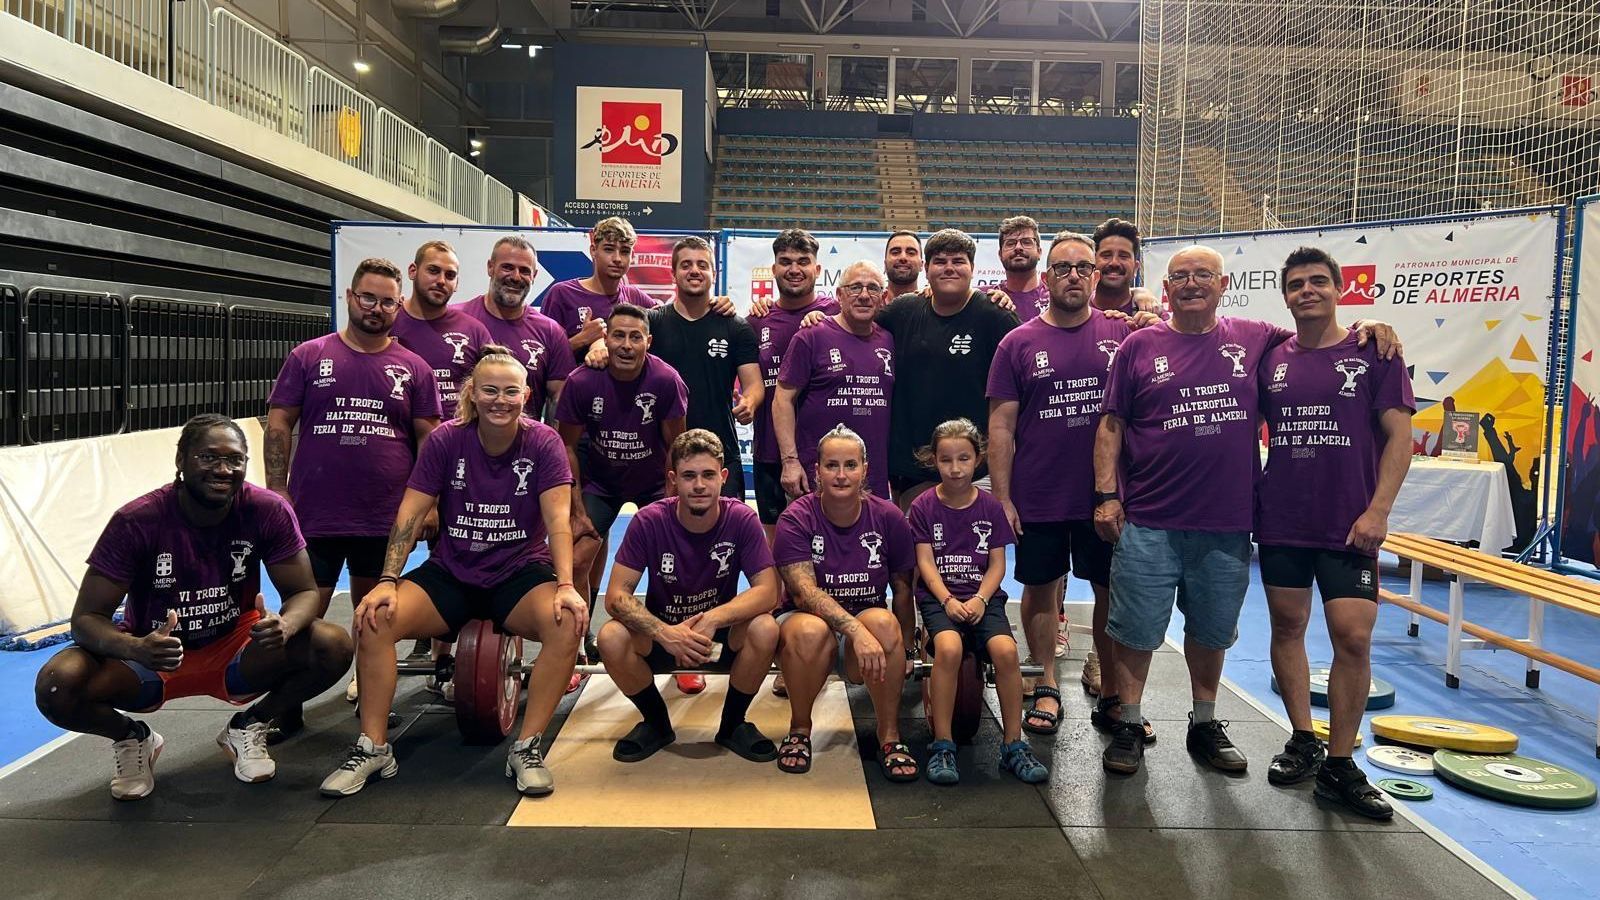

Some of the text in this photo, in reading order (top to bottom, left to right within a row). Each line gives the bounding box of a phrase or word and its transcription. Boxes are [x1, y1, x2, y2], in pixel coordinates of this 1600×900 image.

[601, 170, 646, 179] DEPORTES
[1394, 261, 1448, 269] PATRONATO
[1451, 257, 1501, 267] MUNICIPAL
[1393, 270, 1504, 288] DEPORTES
[1392, 286, 1520, 304] DE ALMERIA
[856, 376, 879, 384] TROFEO
[1054, 377, 1098, 390] VI TROFEO
[837, 388, 884, 396] HALTEROFILIA
[1180, 383, 1230, 397] VI TROFEO
[336, 398, 383, 409] VI TROFEO
[827, 398, 848, 406] FERIA
[1172, 397, 1238, 414] HALTEROFILIA
[1039, 408, 1062, 419] FERIA
[1066, 406, 1077, 416] DE
[1282, 406, 1330, 416] VI TROFEO
[326, 411, 388, 424] HALTEROFILIA
[1163, 410, 1247, 430] FERIA DE ALMERIA
[314, 424, 396, 438] FERIA DE ALMERIA
[1195, 424, 1221, 436] 2024
[1277, 421, 1338, 432] ALTEROFILIA
[612, 431, 638, 440] TROFEO
[1292, 435, 1302, 445] DE
[1307, 435, 1351, 446] ALMERIA
[608, 448, 653, 460] DE ALMERIA
[465, 502, 510, 514] VI TROFEO
[456, 515, 516, 529] HALTEROFILIA
[472, 530, 483, 540] DE
[487, 530, 527, 542] ALMERIA
[825, 572, 869, 584] VI TROFEO
[179, 591, 190, 602] VI
[673, 588, 717, 604] VI TROFEO
[189, 620, 202, 630] DE
